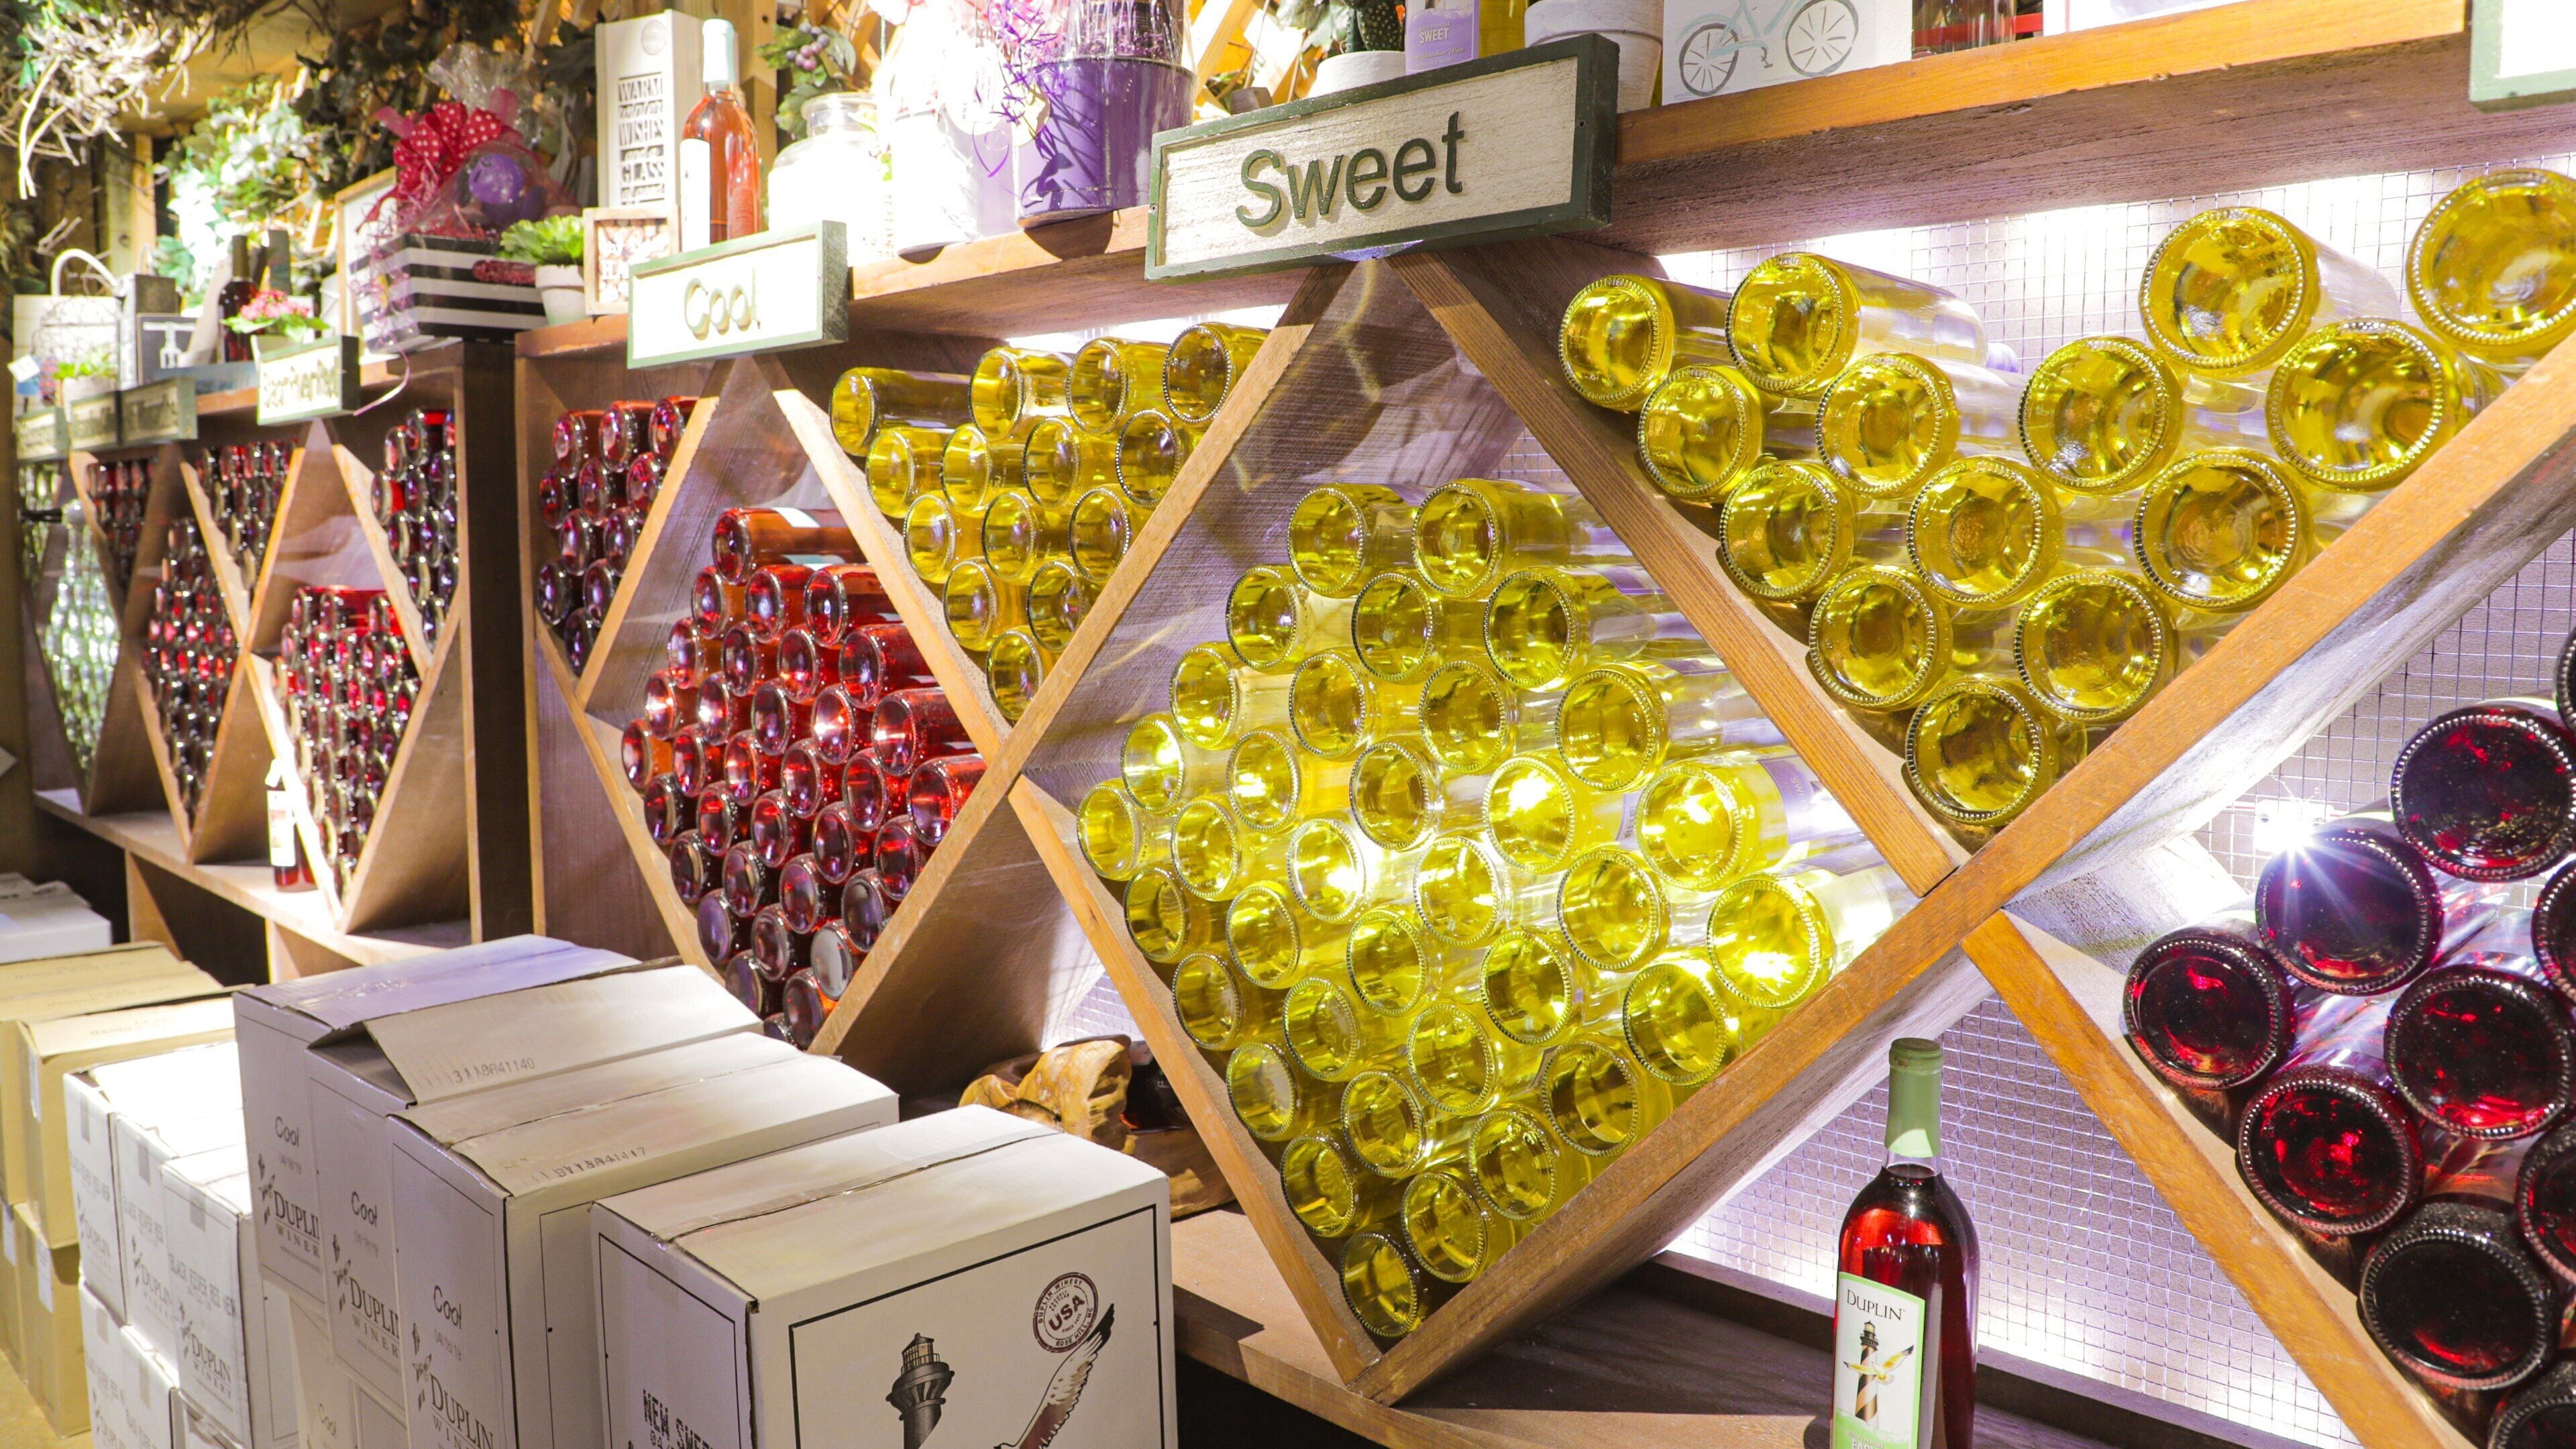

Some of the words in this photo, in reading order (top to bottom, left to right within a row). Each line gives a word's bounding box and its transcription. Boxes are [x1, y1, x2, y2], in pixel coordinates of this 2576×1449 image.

[1419, 28, 1450, 44] SWEET
[618, 78, 663, 102] WARM
[619, 119, 663, 146] WISHES
[620, 162, 664, 184] GLASS
[1235, 111, 1464, 227] Sweet
[684, 268, 760, 341] Cool
[275, 1116, 299, 1148] Cool
[352, 1191, 377, 1228] Cool
[276, 1223, 320, 1258] WINER
[433, 1285, 462, 1330] Cool
[1038, 1291, 1053, 1324] DUPLIN
[1055, 1278, 1083, 1290] WINERY
[1048, 1295, 1085, 1331] USA
[1846, 1289, 1902, 1321] DUPLIN
[352, 1313, 399, 1358] WINER
[1055, 1338, 1073, 1347] ROSE
[191, 1333, 231, 1384] DUPLIN
[319, 1403, 337, 1440] Cool
[430, 1373, 494, 1449] DUPLIN
[643, 1389, 669, 1441] NEW
